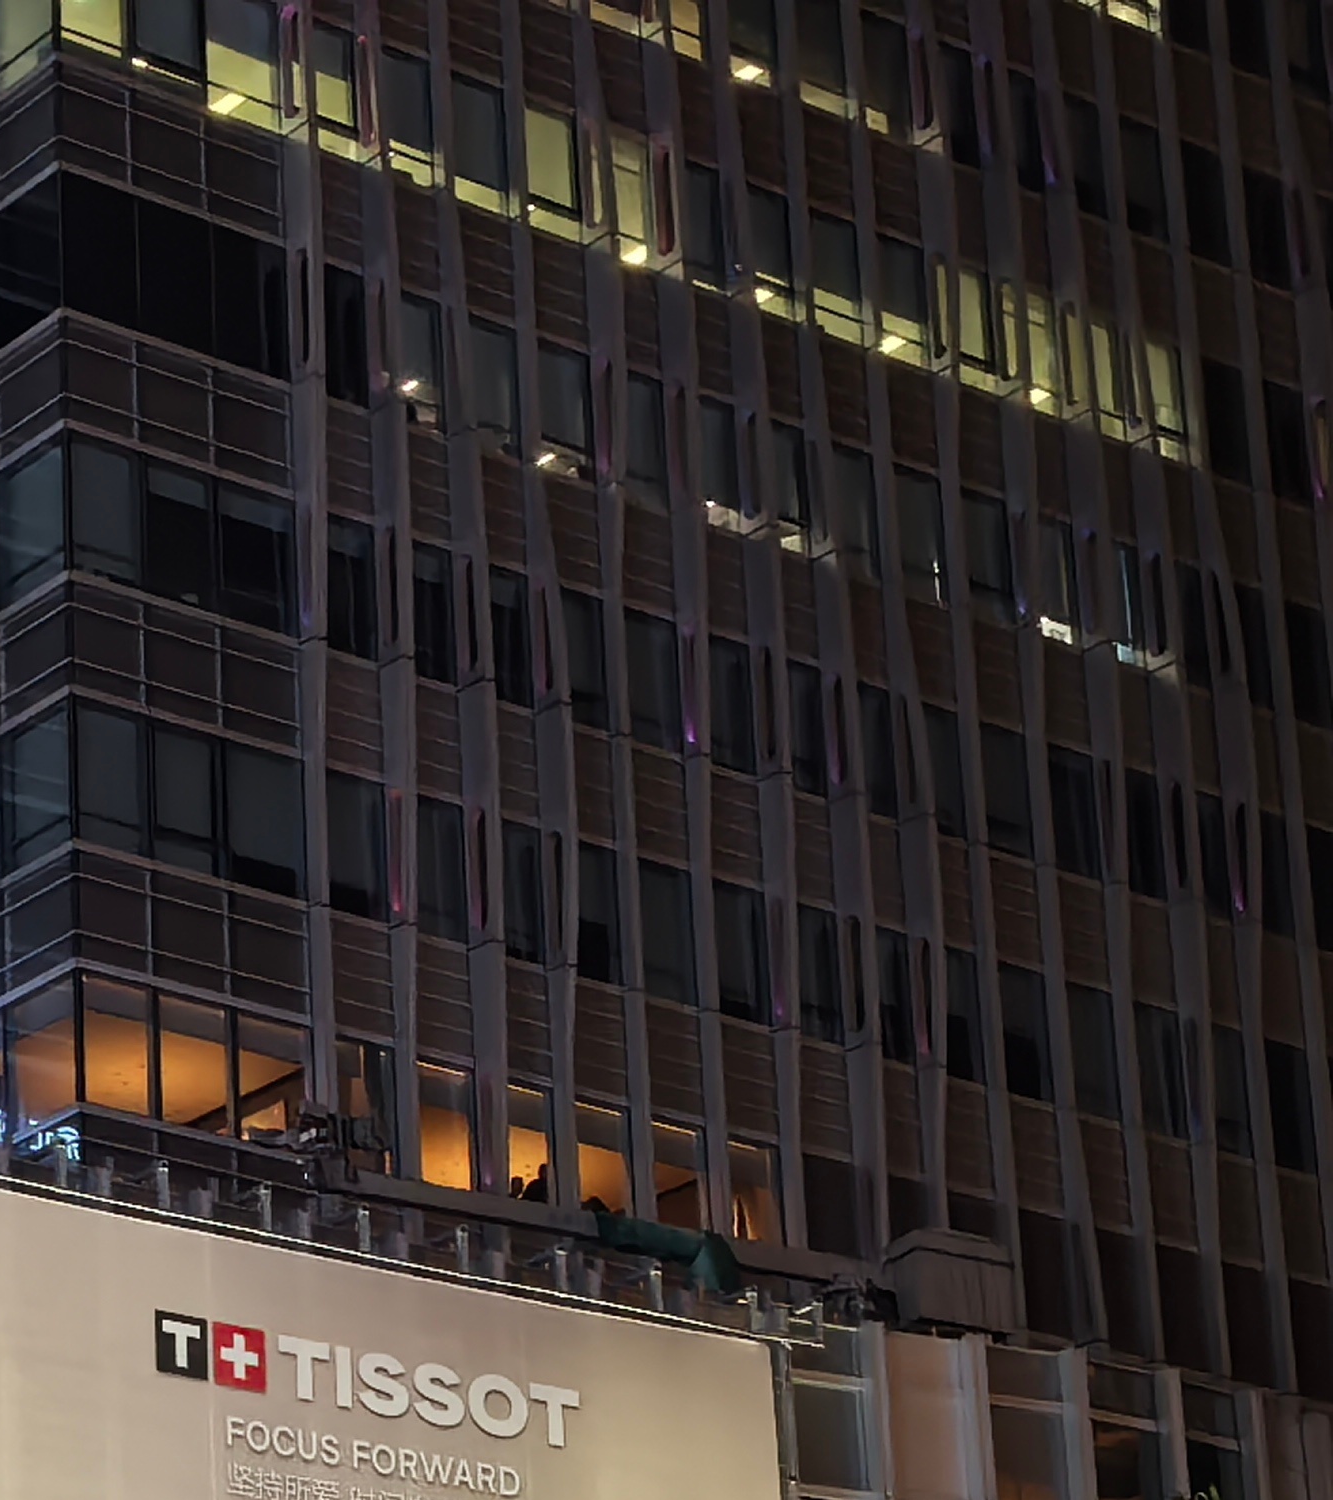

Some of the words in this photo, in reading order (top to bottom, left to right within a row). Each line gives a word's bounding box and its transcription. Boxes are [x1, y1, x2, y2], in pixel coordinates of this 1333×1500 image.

[277, 1333, 582, 1449] TISSOT
[226, 1415, 341, 1466] FOCUS
[352, 1439, 521, 1498] FORWARD
